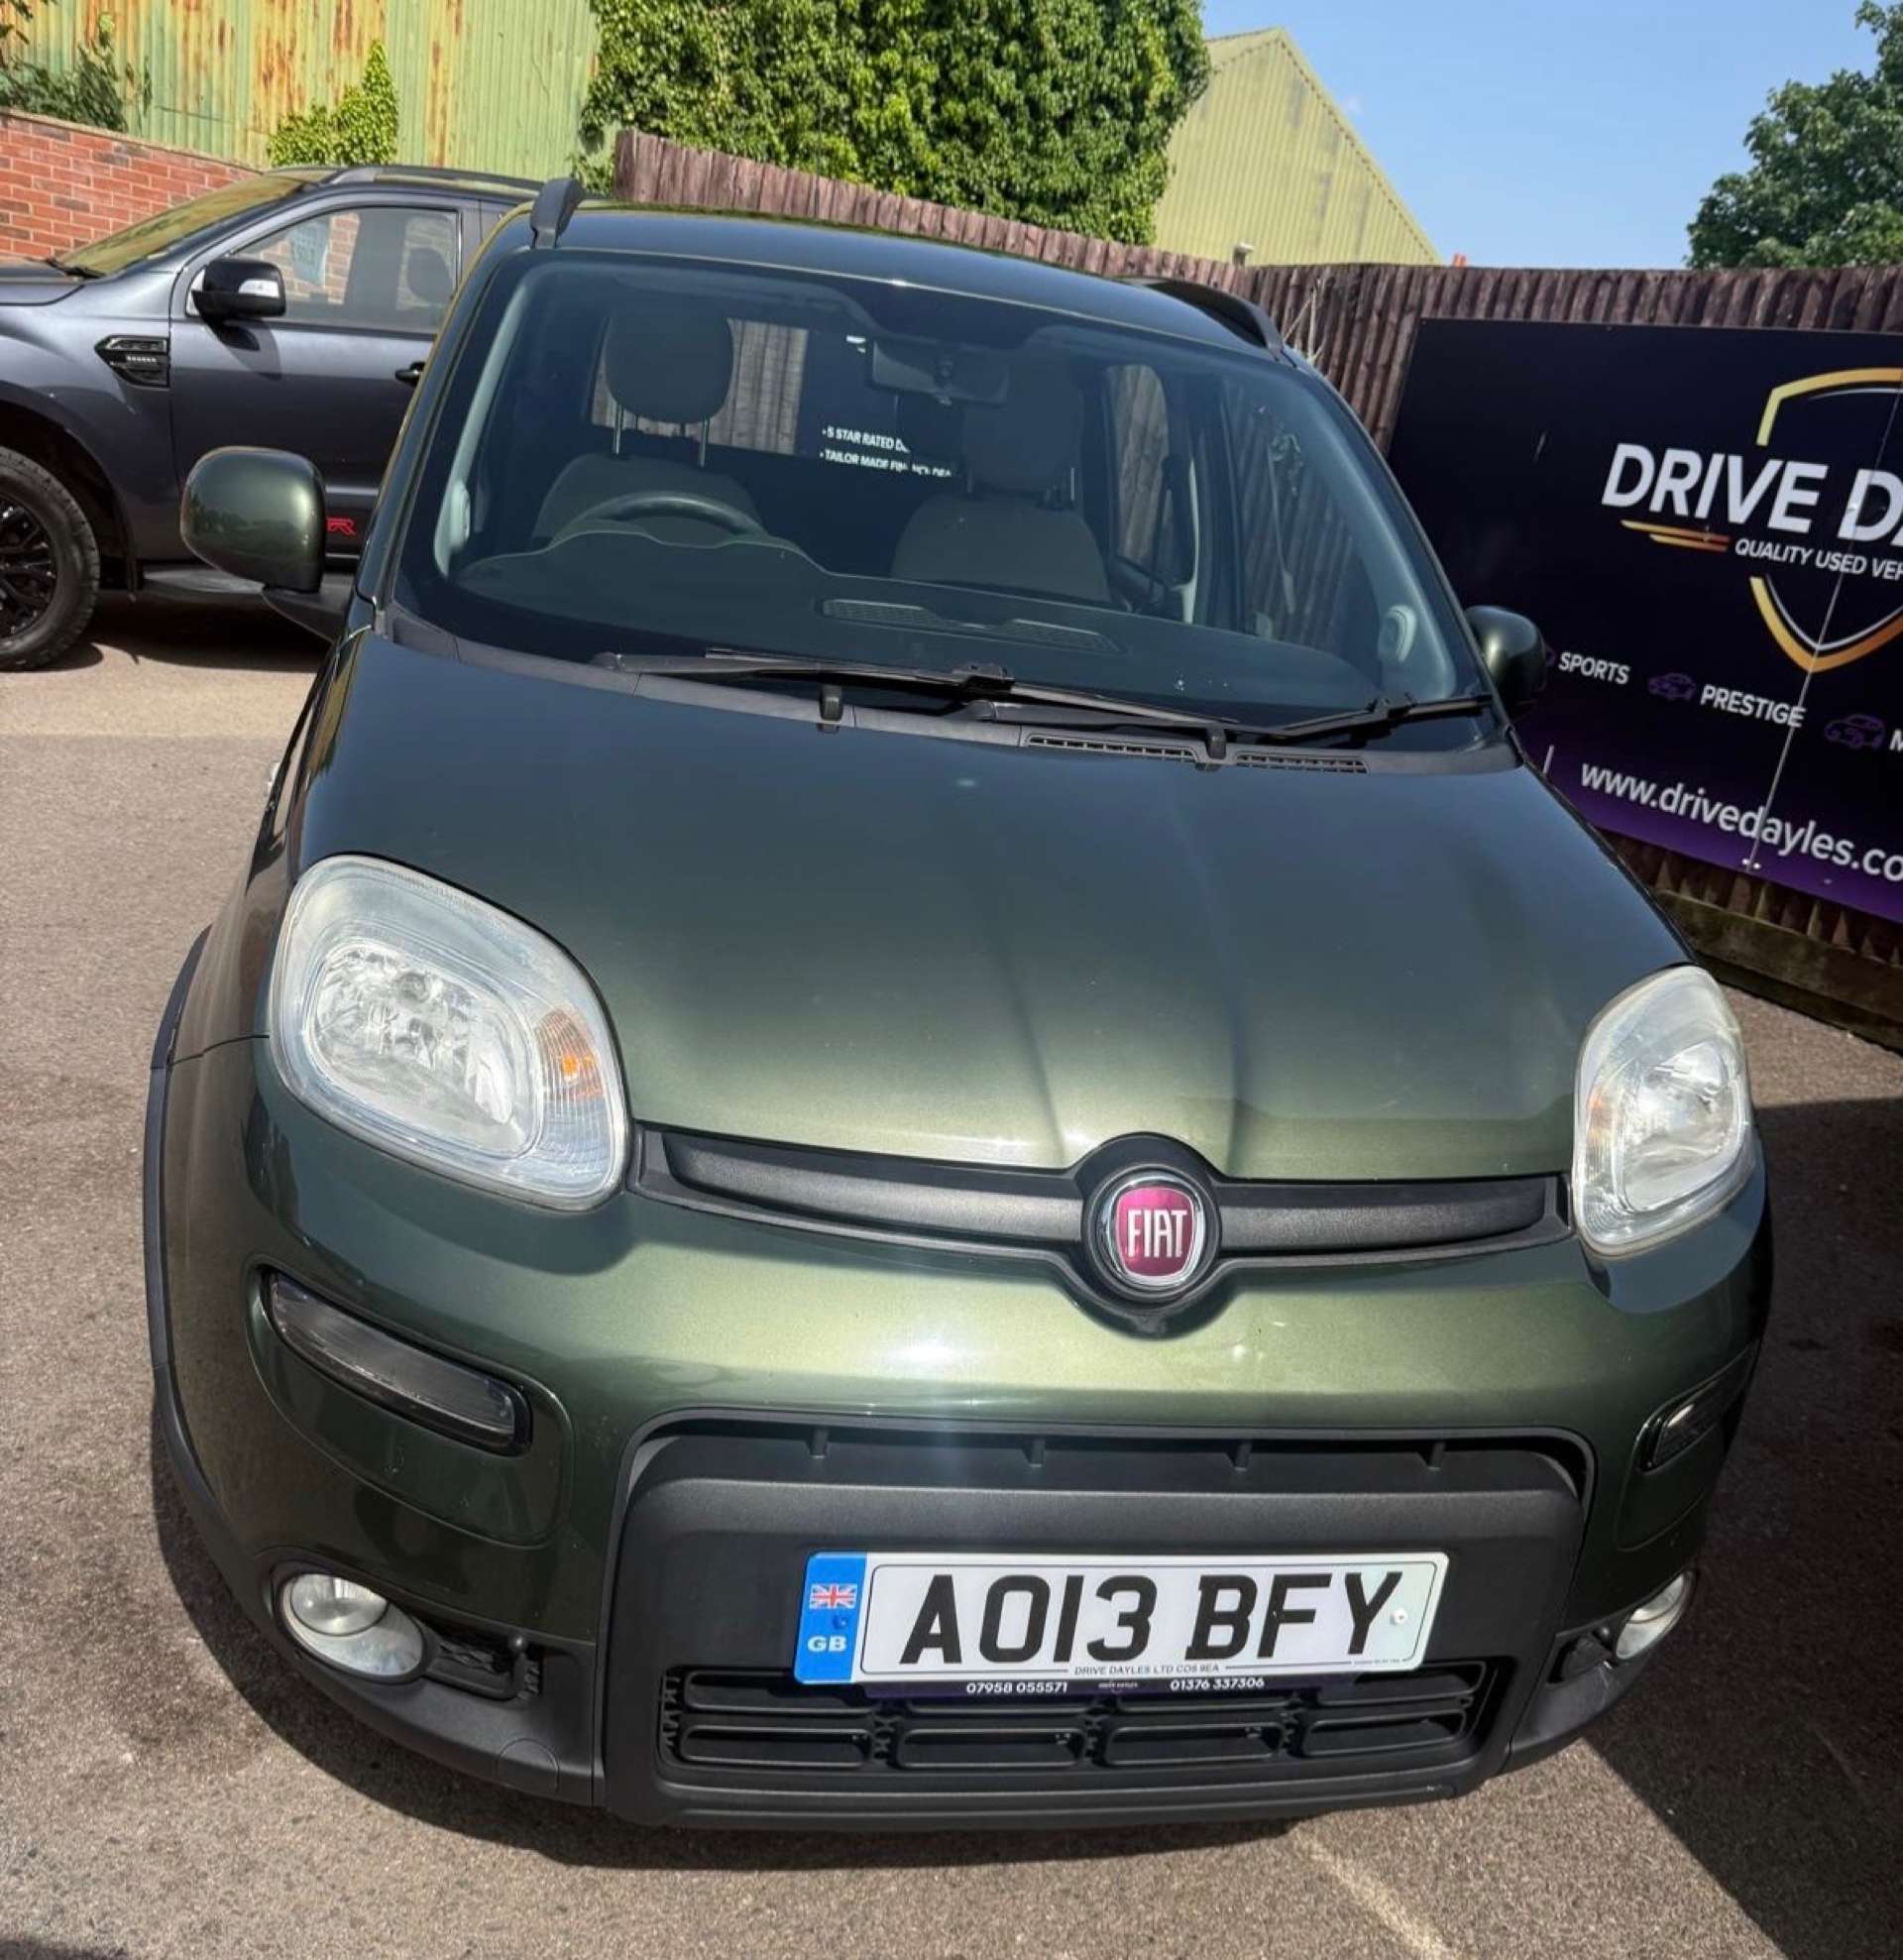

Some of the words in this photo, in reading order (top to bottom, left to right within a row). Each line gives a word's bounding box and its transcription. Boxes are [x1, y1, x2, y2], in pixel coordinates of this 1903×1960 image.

[837, 427, 861, 444] STAR
[862, 432, 894, 449] RATED
[825, 448, 859, 465] TAILOR
[860, 455, 889, 469] MADE
[1602, 442, 1829, 533] DRIVE
[1838, 468, 1903, 546] D
[1735, 538, 1813, 566] QUALITY
[1815, 549, 1868, 575] USED
[1558, 651, 1630, 685] SPORTS
[1700, 683, 1807, 728] PRESTIGE
[1126, 1208, 1188, 1259] FIAT
[899, 1573, 1159, 1665] AO13
[1184, 1571, 1402, 1662] BFY
[807, 1634, 847, 1654] GB
[1074, 1666, 1106, 1676] DRIVE
[1109, 1665, 1151, 1675] DAYLES
[1154, 1665, 1174, 1674] LTD
[966, 1681, 1013, 1694] 07958
[1016, 1681, 1068, 1694] 055571
[1170, 1678, 1210, 1692] 01376
[1212, 1676, 1266, 1691] 337306
